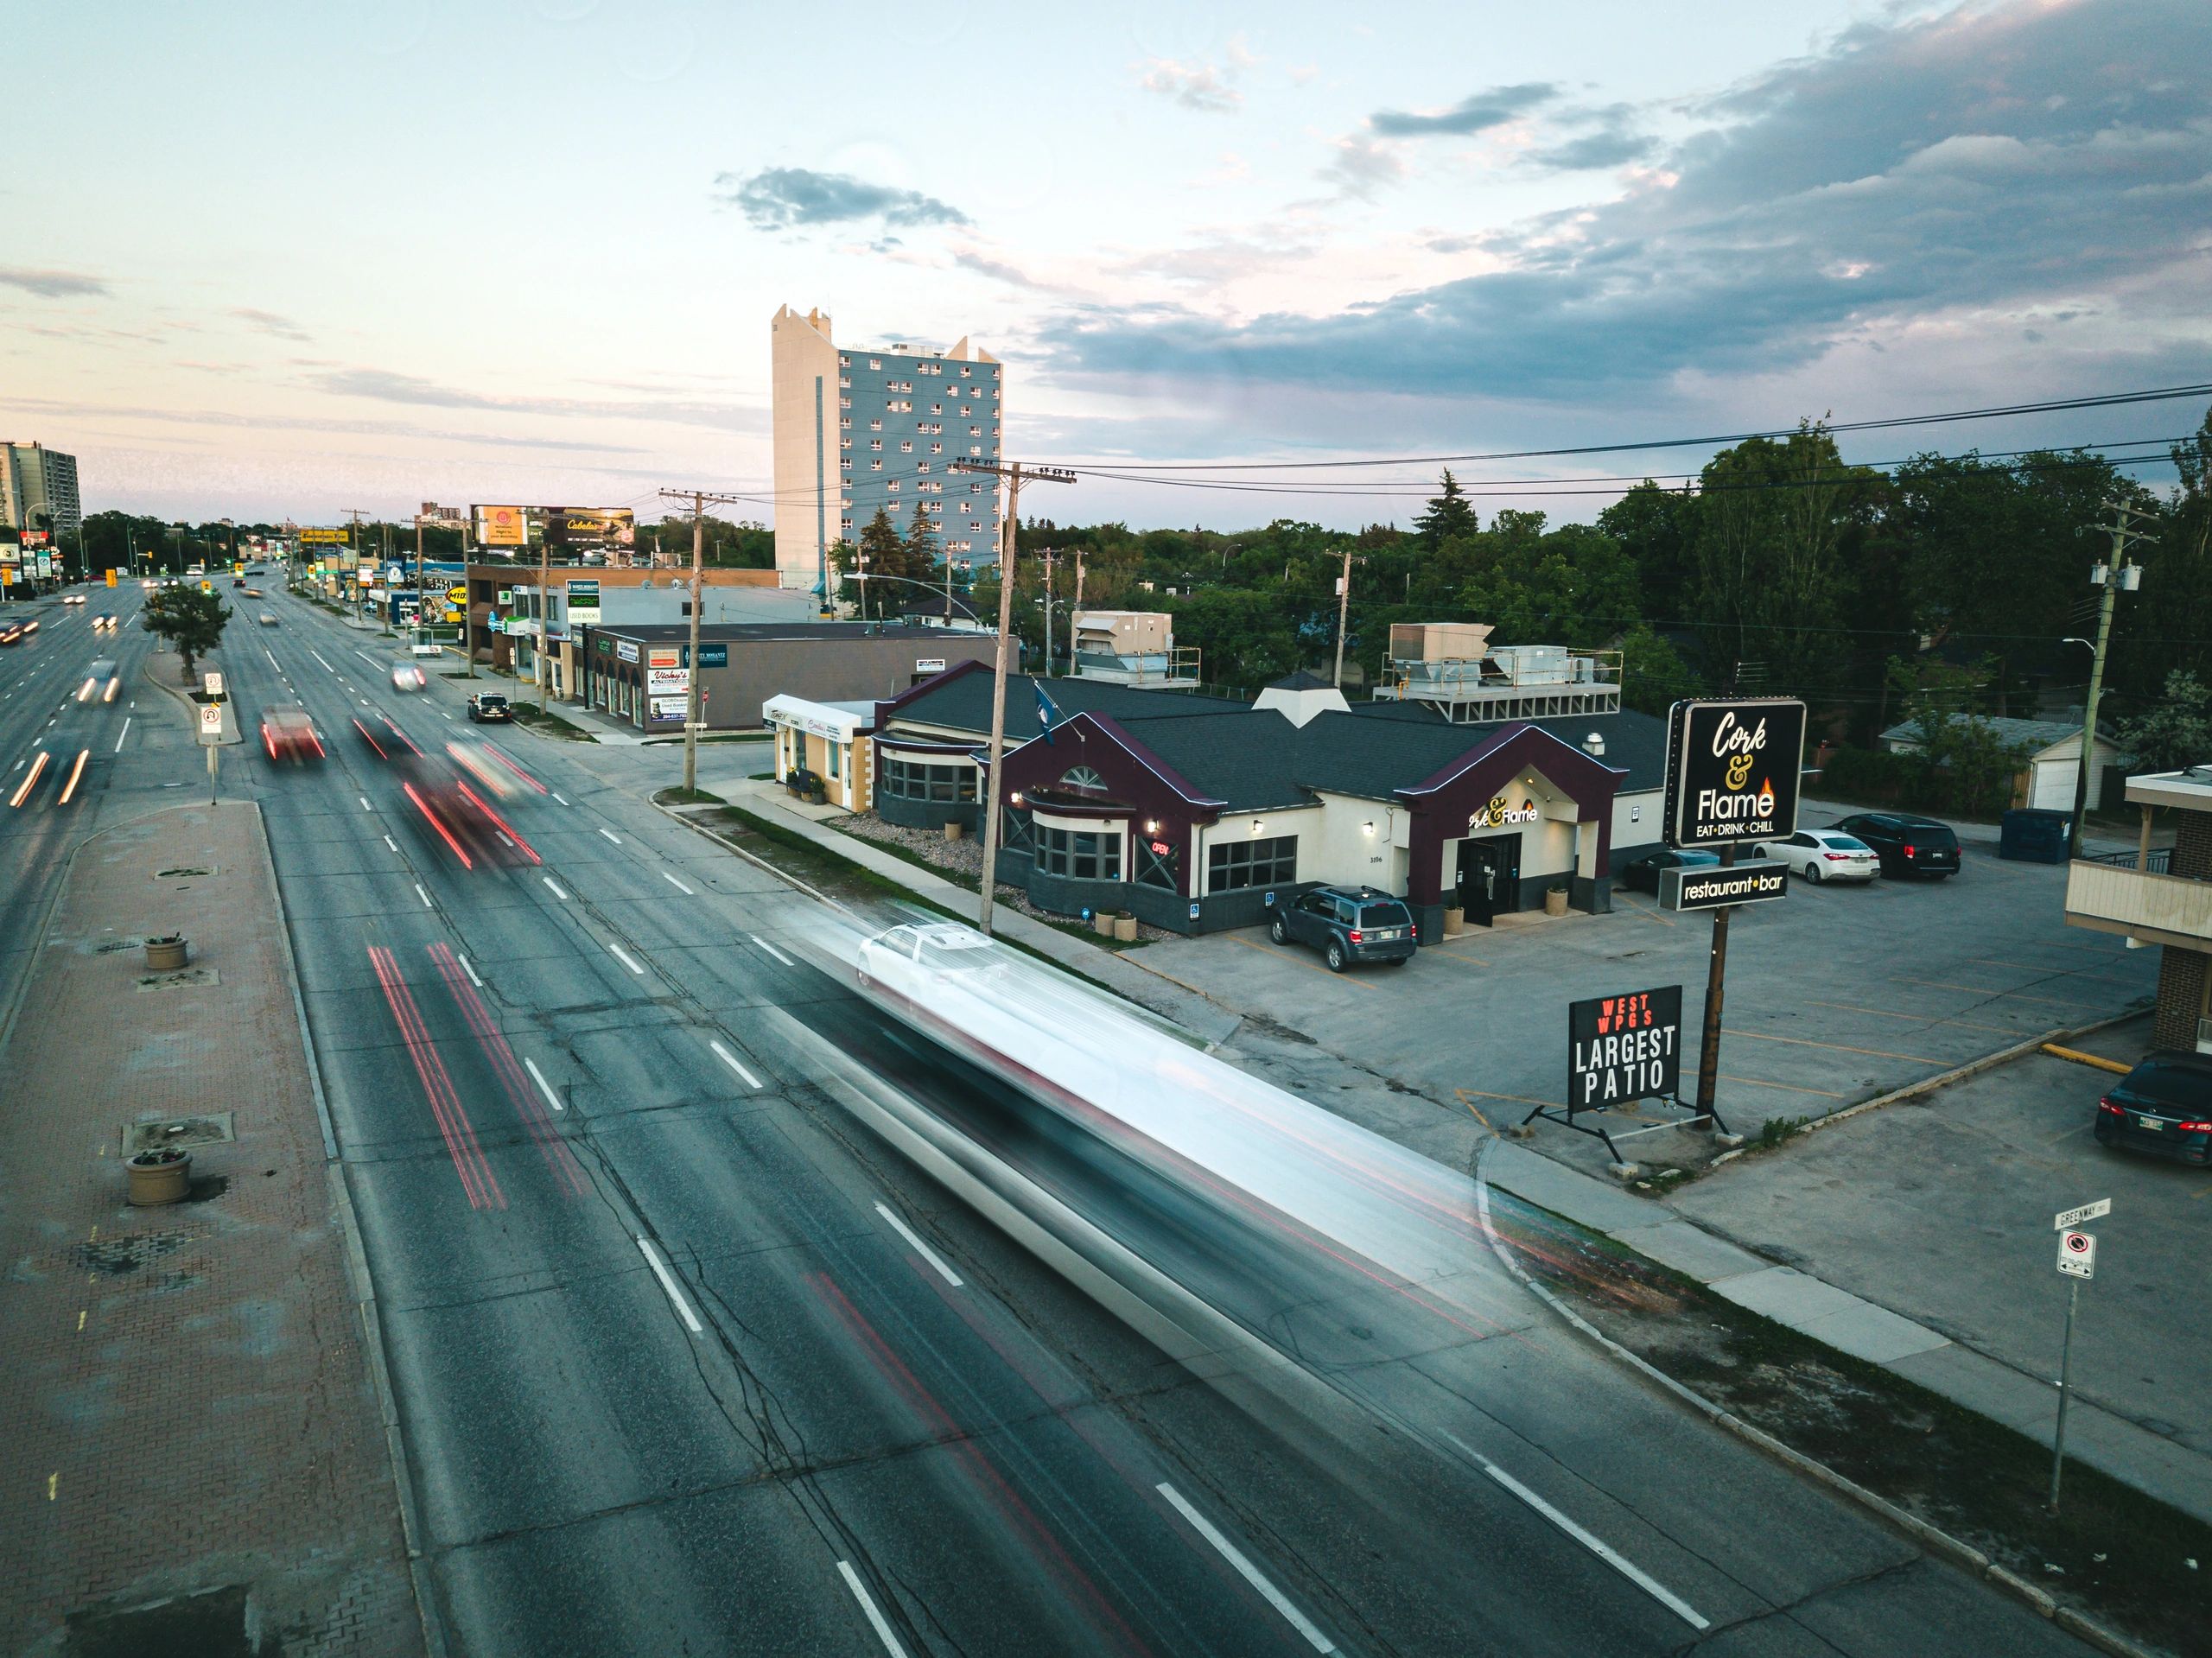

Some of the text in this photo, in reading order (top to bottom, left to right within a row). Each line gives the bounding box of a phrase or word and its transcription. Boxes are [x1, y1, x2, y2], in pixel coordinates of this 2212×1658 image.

[654, 670, 688, 680] Vicky's
[1712, 711, 1766, 758] Cork
[1726, 753, 1753, 791] &
[1698, 788, 1775, 820] Flame
[1469, 810, 1489, 829] ork
[1502, 808, 1538, 825] Flame
[1152, 842, 1169, 855] OPEN
[1602, 994, 1649, 1017] WEST
[1575, 1025, 1676, 1074] LARGEST
[1585, 1059, 1664, 1104] PATIO
[2061, 1205, 2096, 1226] GREENWAY
